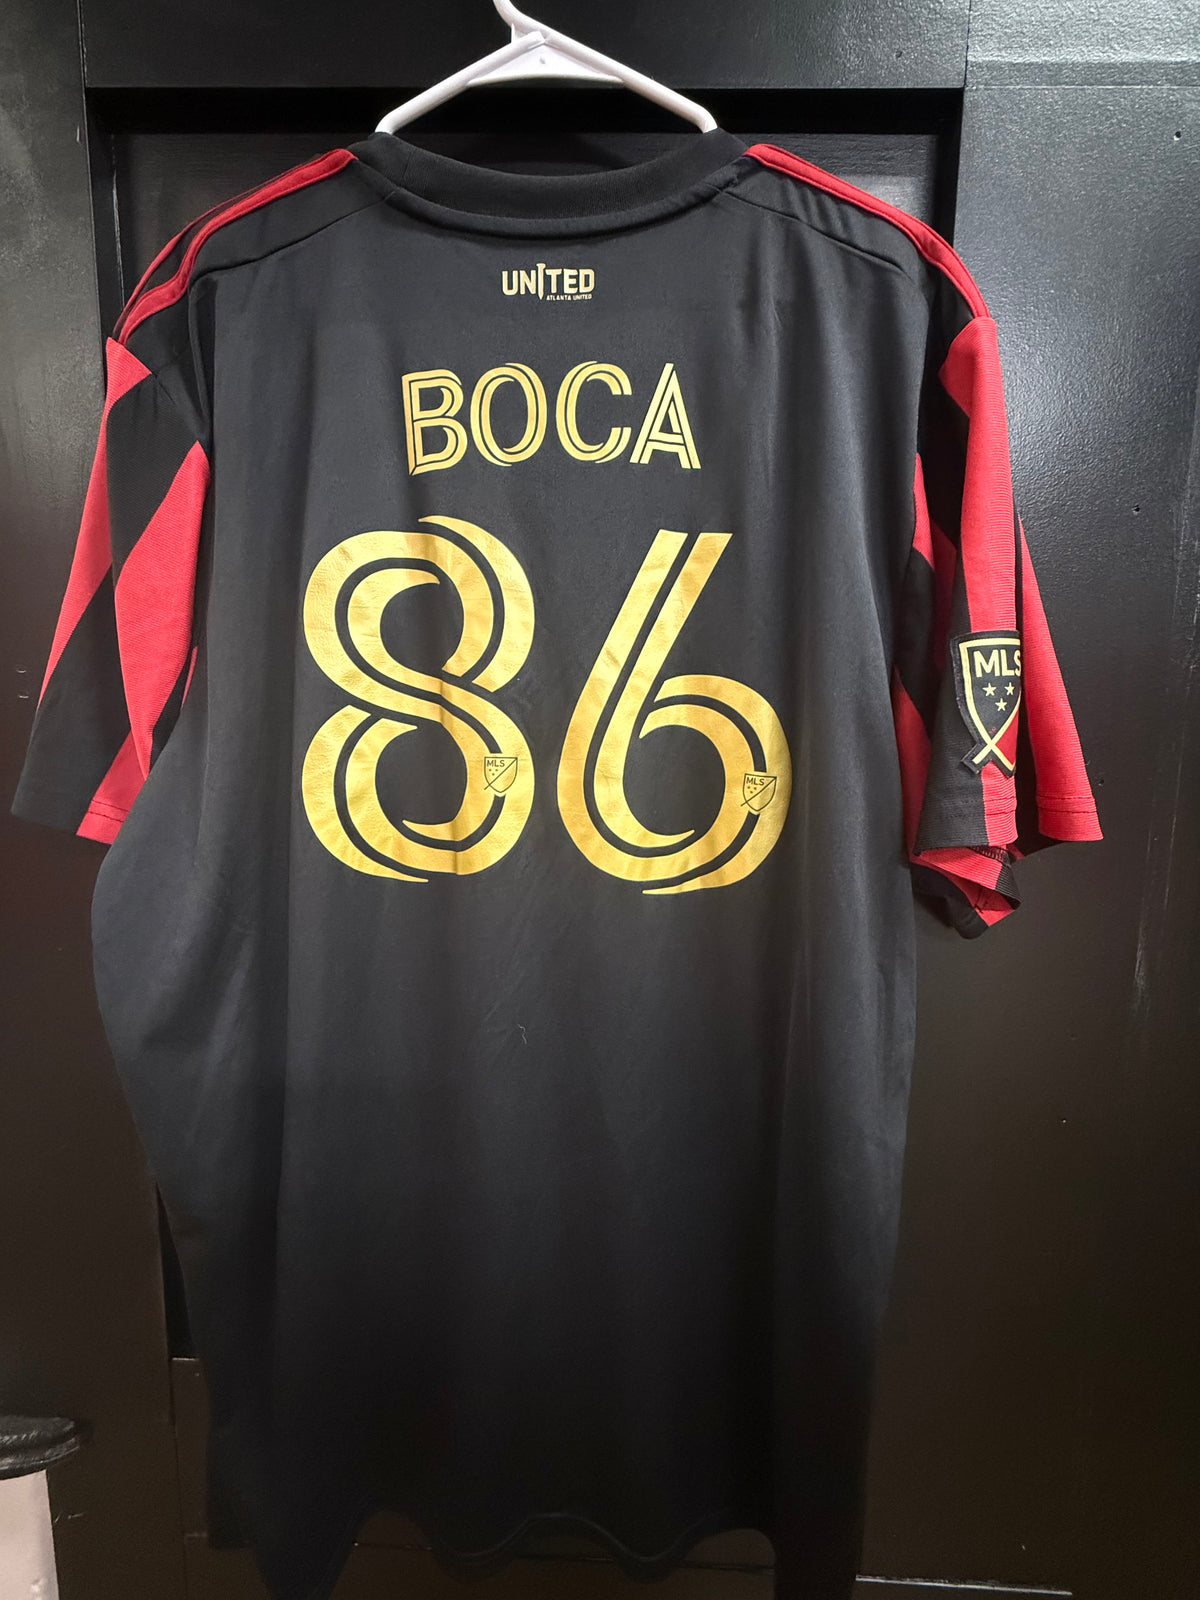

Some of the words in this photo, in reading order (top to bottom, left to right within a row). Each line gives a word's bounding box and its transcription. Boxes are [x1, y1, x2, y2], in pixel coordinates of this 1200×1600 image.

[502, 263, 595, 300] UNITED
[401, 361, 701, 475] BOCA
[301, 515, 793, 895] 86
[486, 759, 505, 767] MLS
[746, 777, 765, 786] MLS
